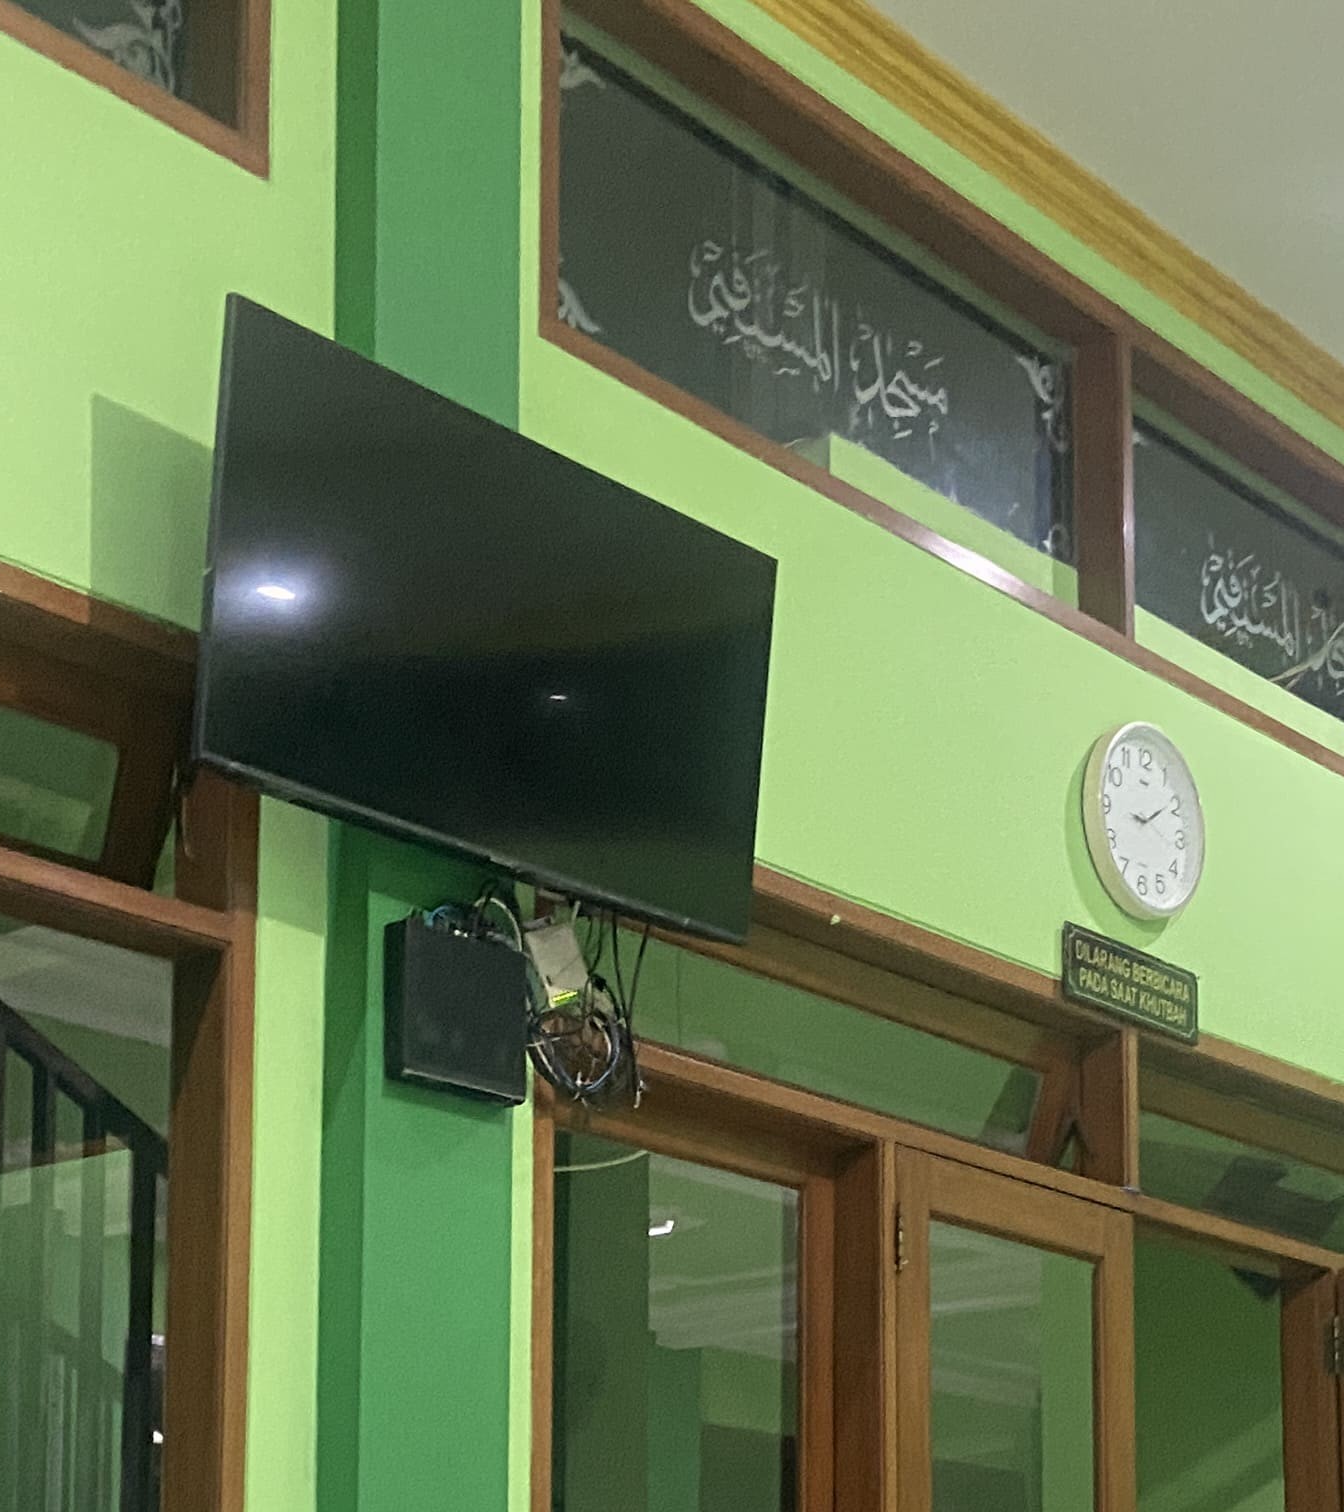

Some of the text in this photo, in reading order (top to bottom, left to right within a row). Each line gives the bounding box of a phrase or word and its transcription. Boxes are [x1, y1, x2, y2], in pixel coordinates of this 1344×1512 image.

[1121, 747, 1131, 769] 11
[1139, 748, 1152, 771] 12
[1108, 764, 1123, 787] 10
[1170, 795, 1181, 817] 2
[1175, 830, 1185, 850] 3
[1120, 856, 1130, 875] 7
[1169, 859, 1178, 878] 4
[1137, 874, 1148, 896] 6
[1156, 874, 1166, 894] 5
[1075, 940, 1130, 978] DILARANG
[1079, 967, 1106, 995] PADA
[1110, 979, 1136, 1006] SAAT
